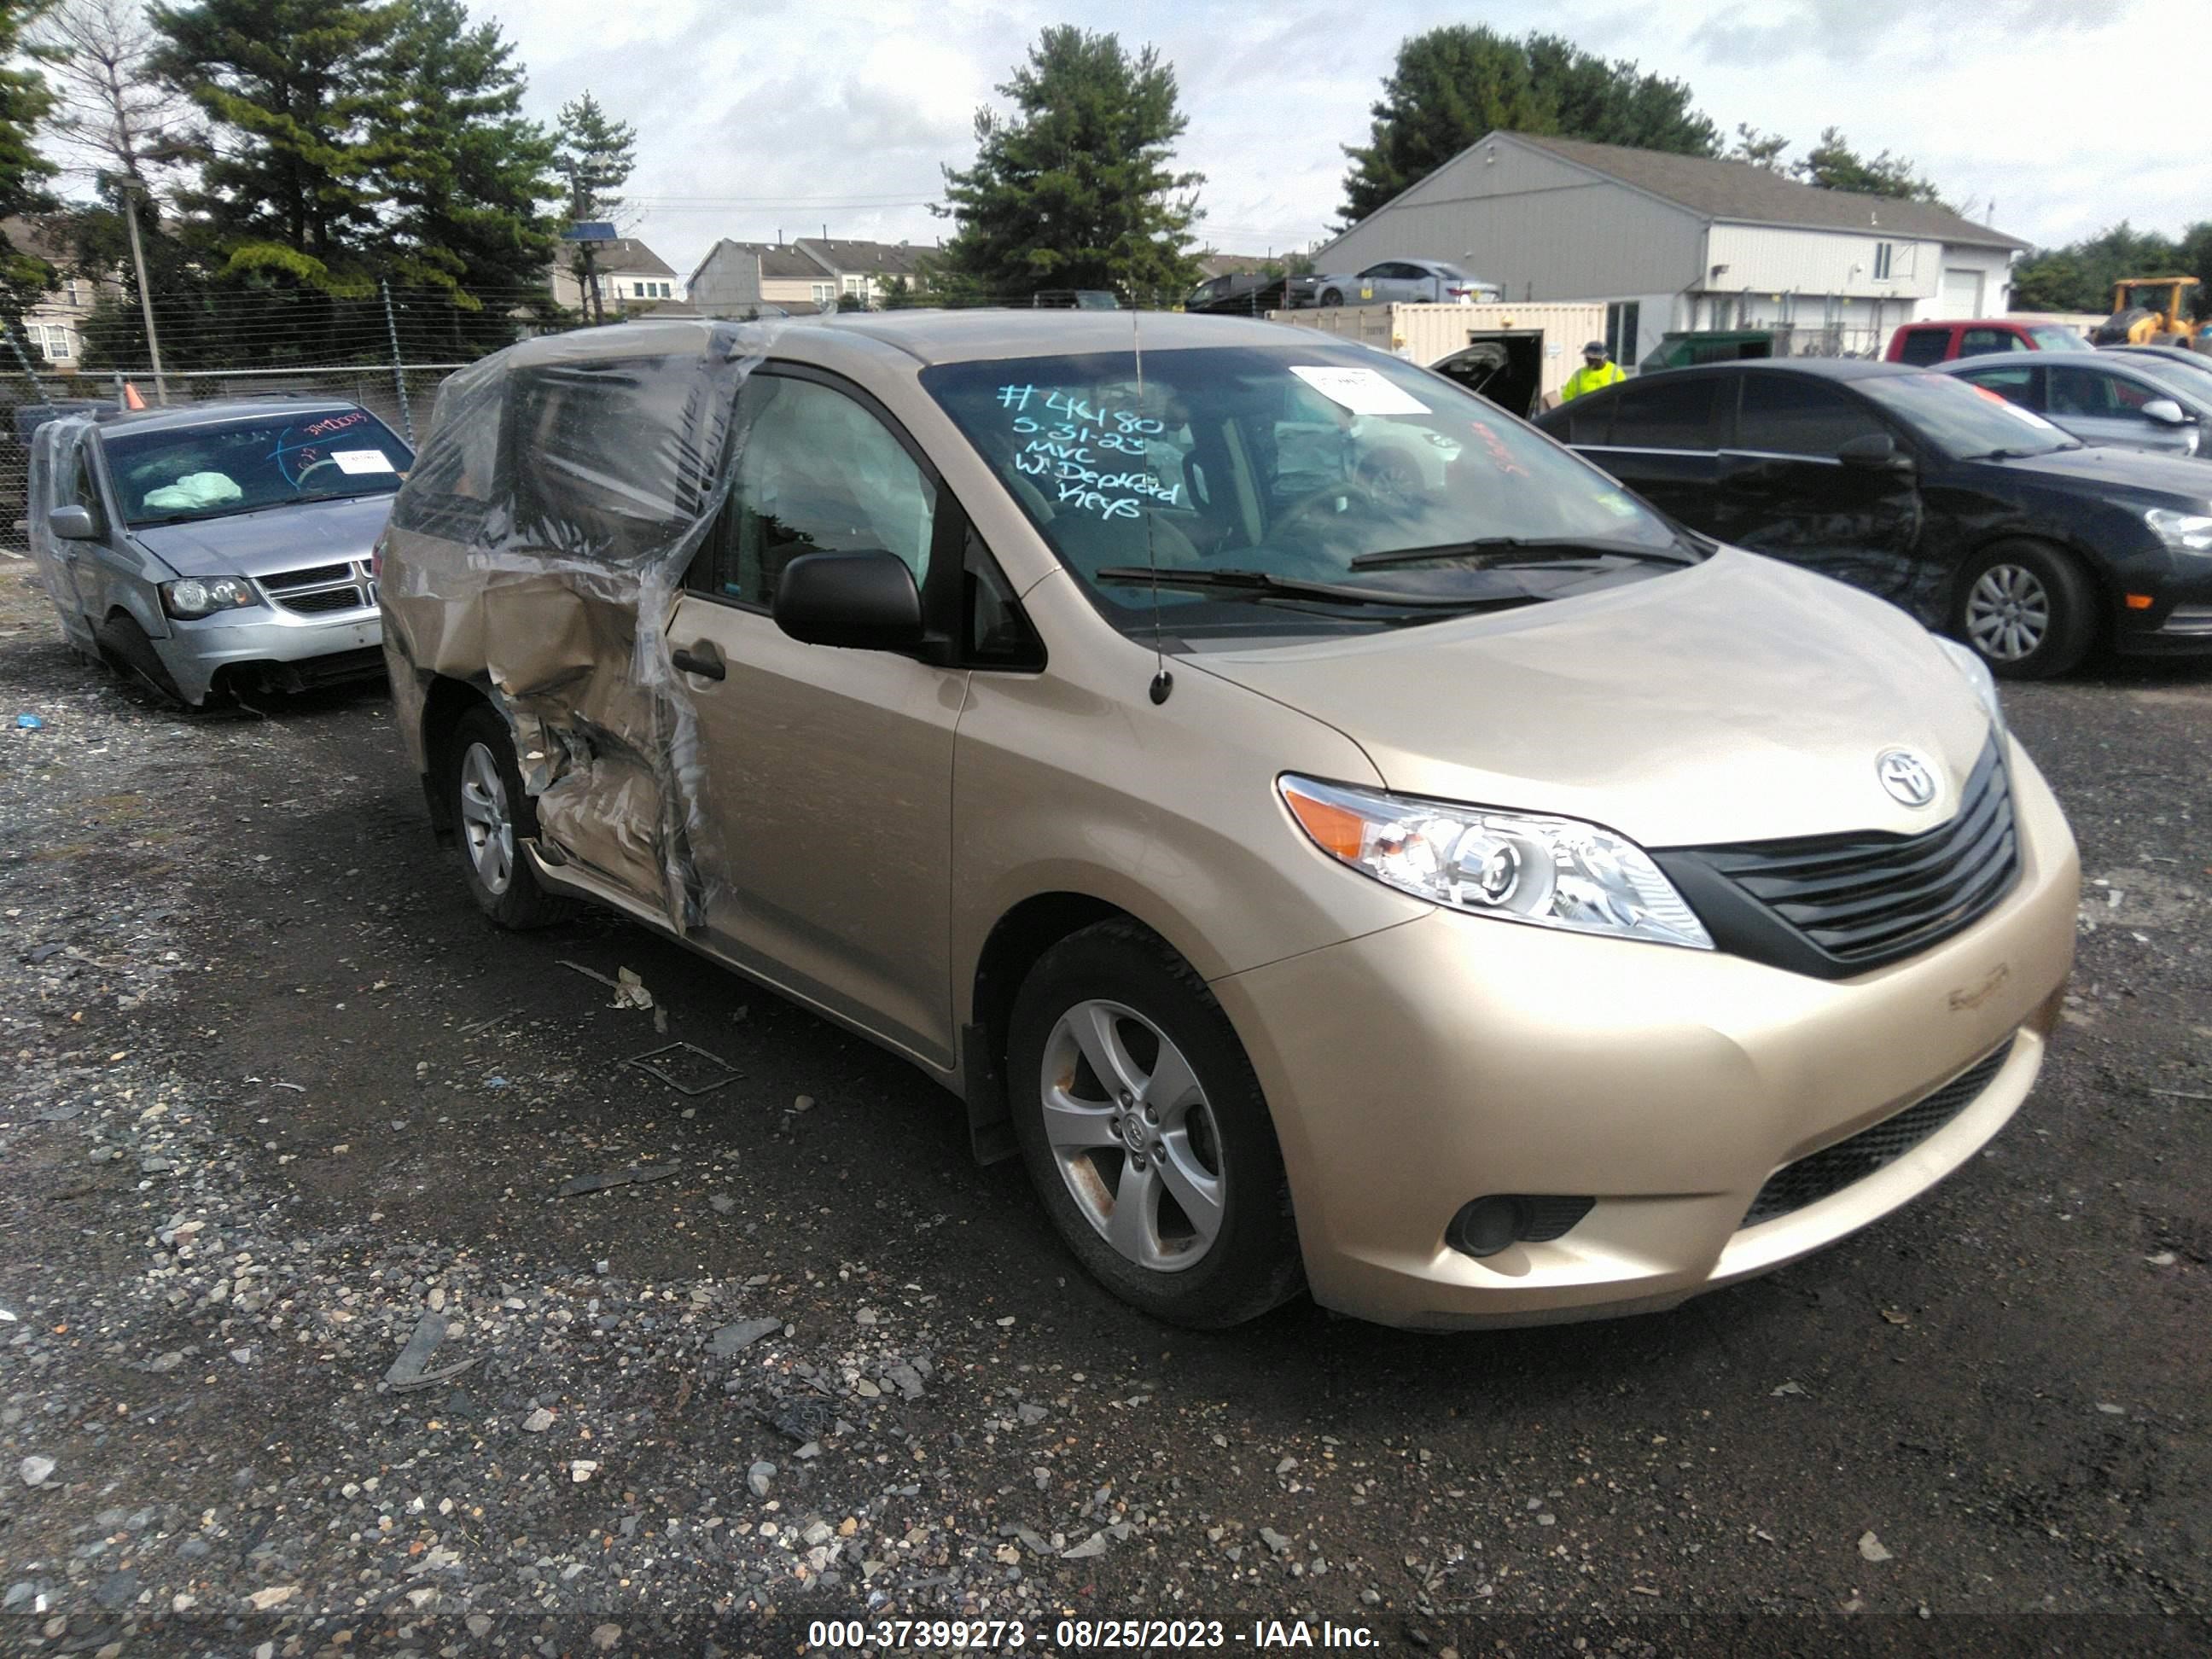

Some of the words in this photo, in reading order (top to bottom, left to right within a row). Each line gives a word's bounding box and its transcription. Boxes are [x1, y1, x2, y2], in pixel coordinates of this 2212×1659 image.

[997, 384, 1038, 410] #
[1025, 440, 1096, 463] MVC
[1058, 483, 1140, 520] Keys
